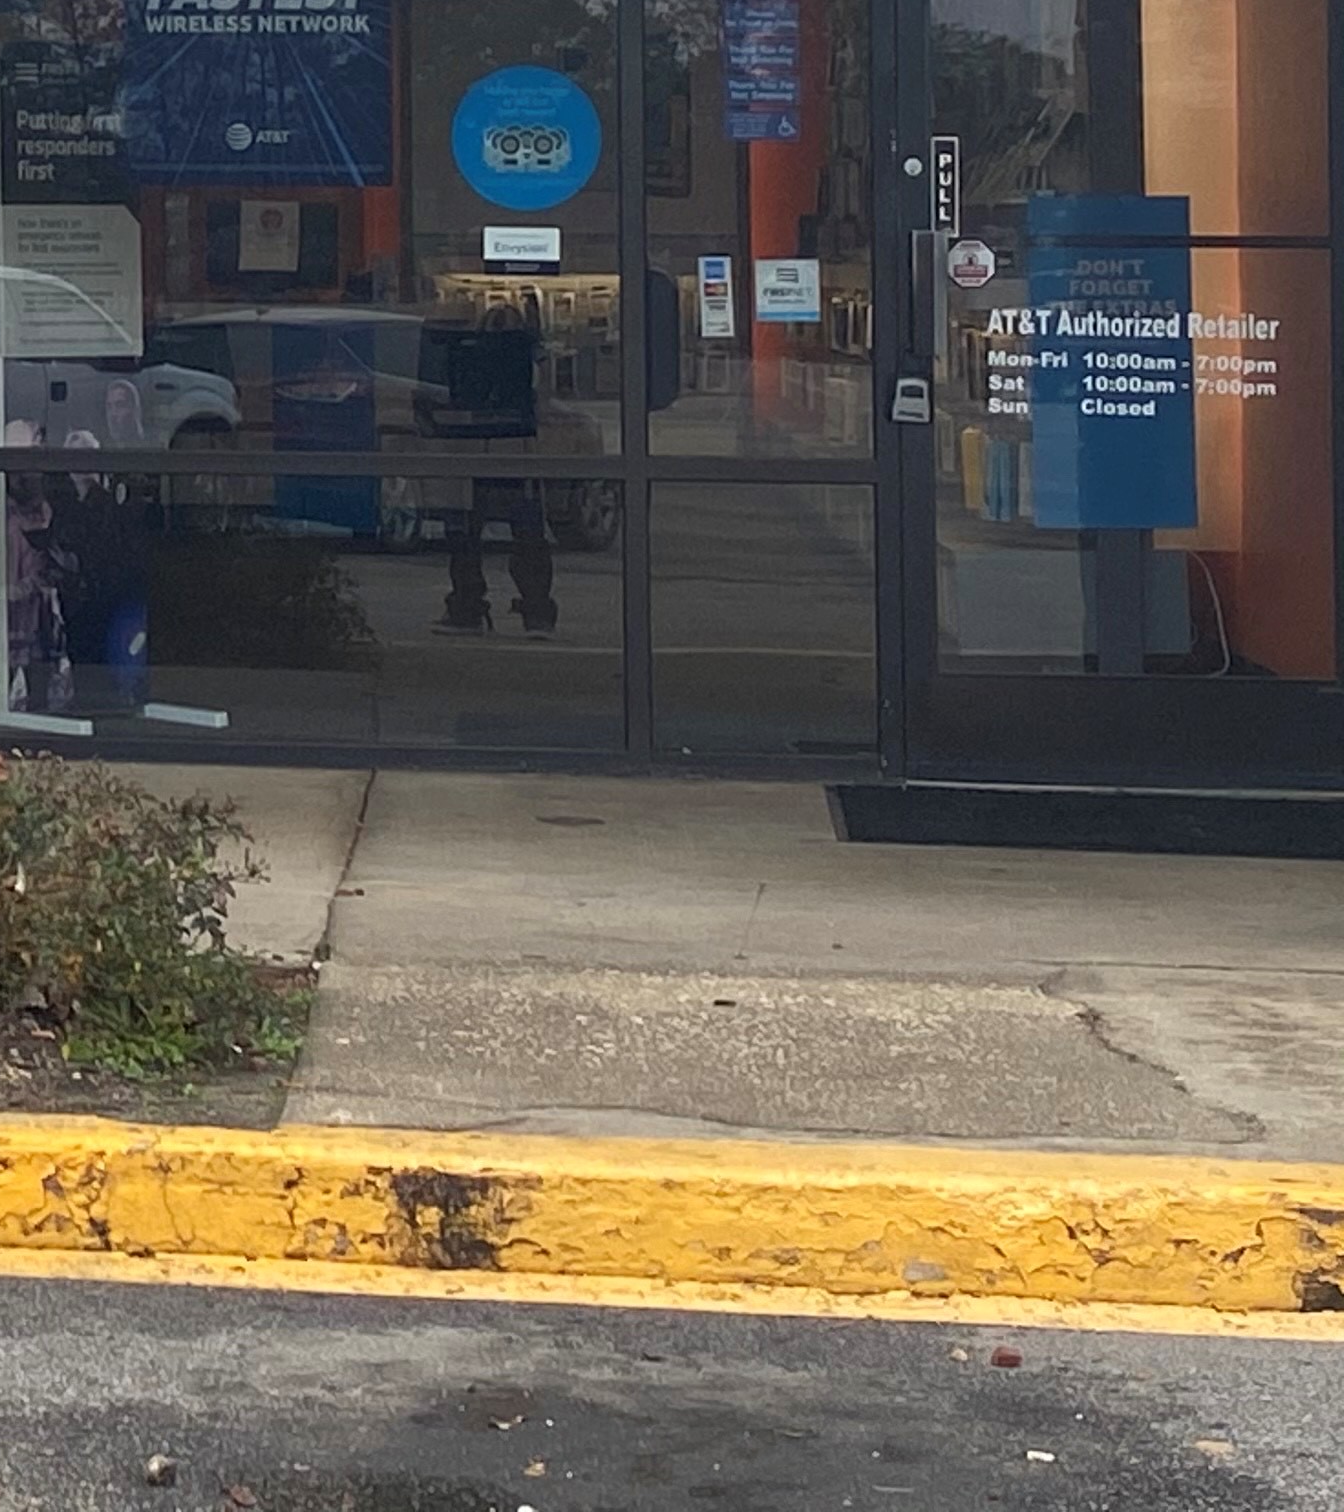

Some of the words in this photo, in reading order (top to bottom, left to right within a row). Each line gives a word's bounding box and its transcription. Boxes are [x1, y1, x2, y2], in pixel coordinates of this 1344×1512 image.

[144, 15, 252, 34] WIRELESS
[257, 14, 371, 35] NETWORK
[16, 109, 83, 134] Putting
[16, 135, 115, 159] responders
[256, 129, 290, 144] AT&T
[16, 159, 56, 182] first
[938, 152, 953, 222] PULL
[1074, 259, 1146, 276] DON'T
[1068, 279, 1154, 296] FORGET
[1090, 299, 1177, 316] EXTRAS
[986, 309, 1053, 336] AT&T
[1056, 310, 1180, 339] Authorized
[1187, 311, 1279, 340] Retailer
[987, 351, 1069, 369] Mon-Fri
[1082, 352, 1177, 372] 10:00am
[1196, 355, 1277, 375] 7:00pm
[988, 374, 1025, 392] Sat
[1082, 375, 1176, 394] 10:00am
[1195, 378, 1277, 398] 7:00pm
[987, 398, 1028, 415] Sun
[1080, 398, 1158, 416] Closed
